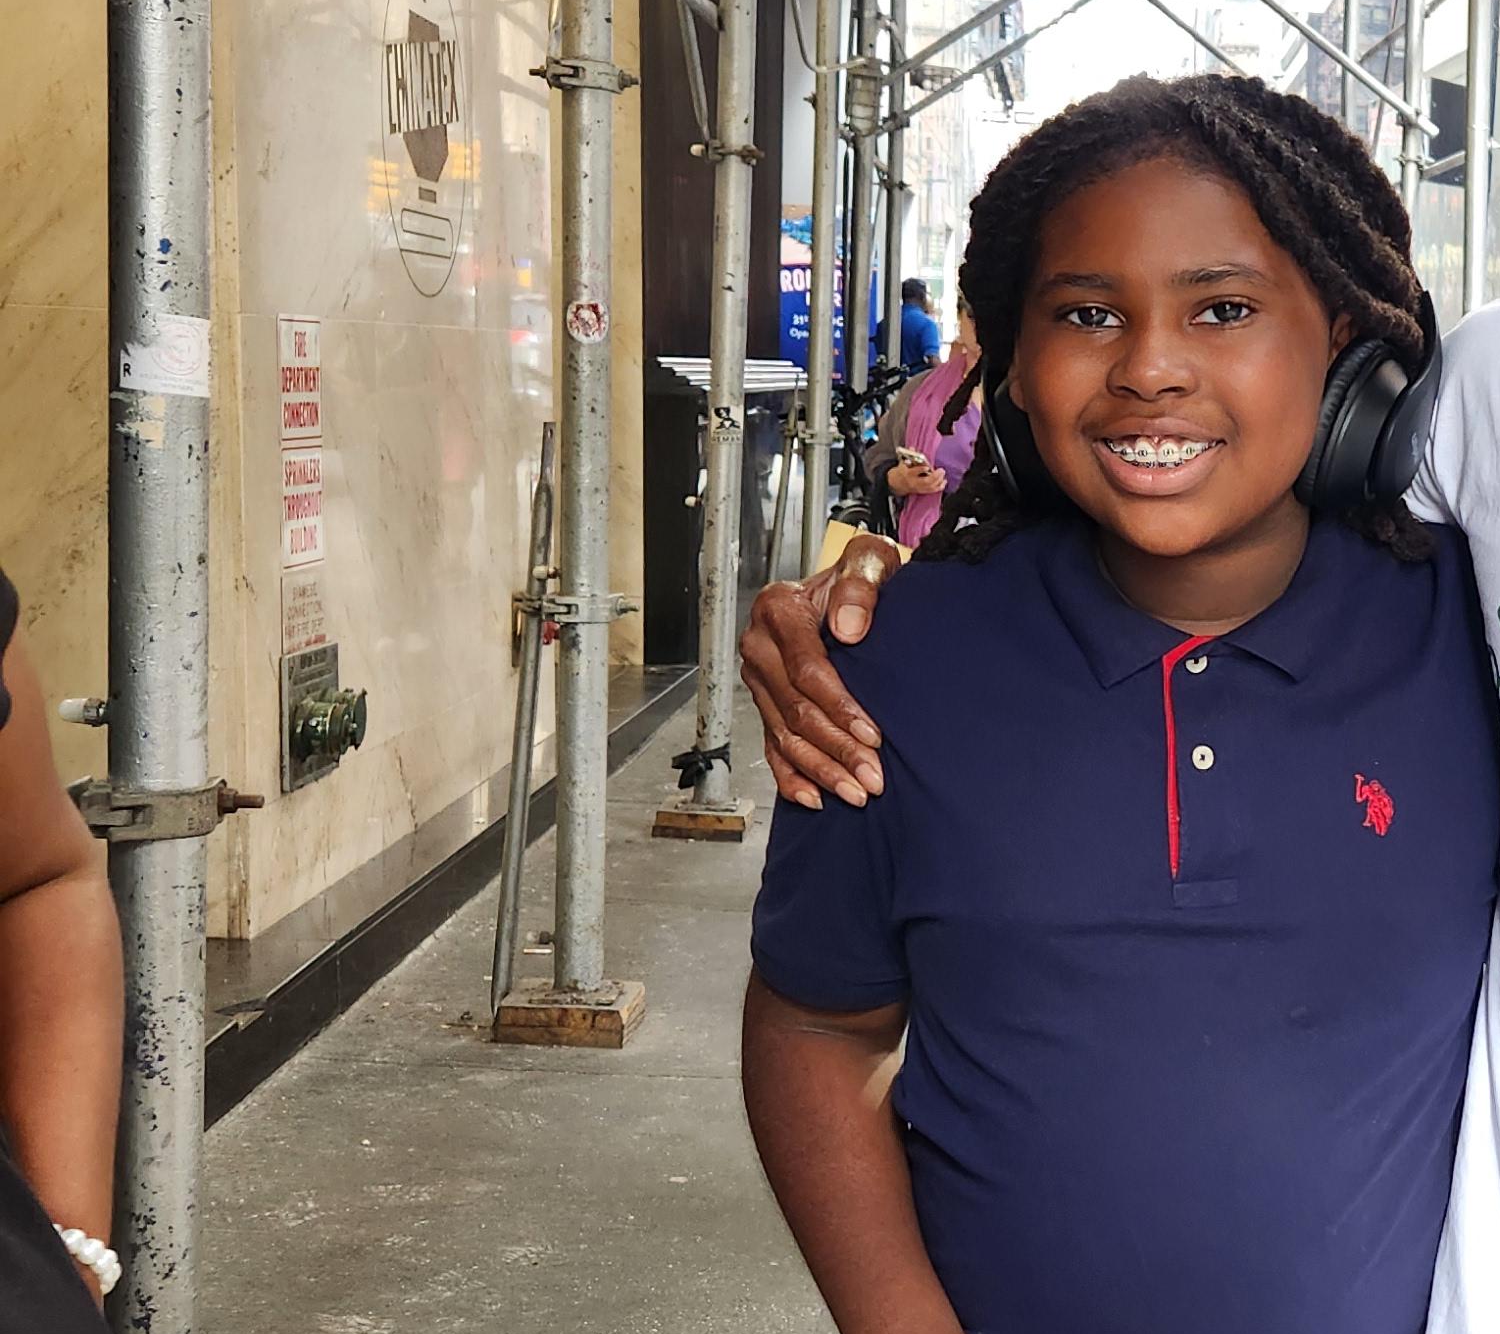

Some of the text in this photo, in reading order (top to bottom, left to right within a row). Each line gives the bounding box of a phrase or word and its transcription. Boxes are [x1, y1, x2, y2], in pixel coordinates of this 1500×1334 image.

[294, 331, 307, 358] FIRE
[281, 367, 320, 393] DEPARTMENT
[283, 402, 320, 429] CONNECTION
[284, 458, 321, 487] SPRINKLERS
[283, 490, 322, 521] THROUGHOUT
[290, 525, 318, 555] BUILDING
